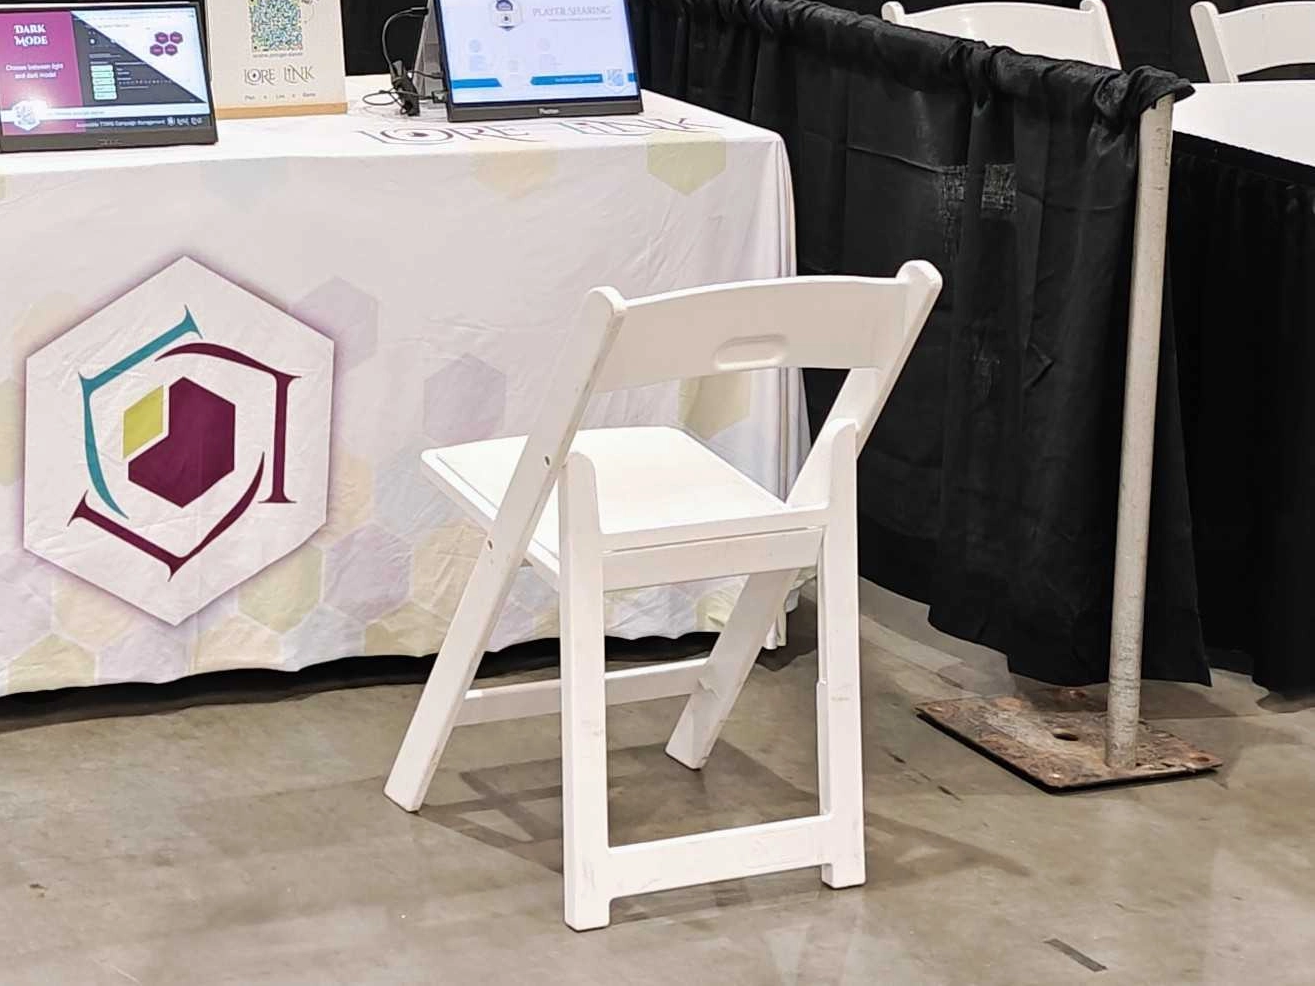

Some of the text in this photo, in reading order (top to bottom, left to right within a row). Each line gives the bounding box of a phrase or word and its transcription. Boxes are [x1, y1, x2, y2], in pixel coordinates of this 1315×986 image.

[13, 23, 47, 34] DARK
[13, 35, 49, 47] MODE
[243, 67, 276, 86] LORE
